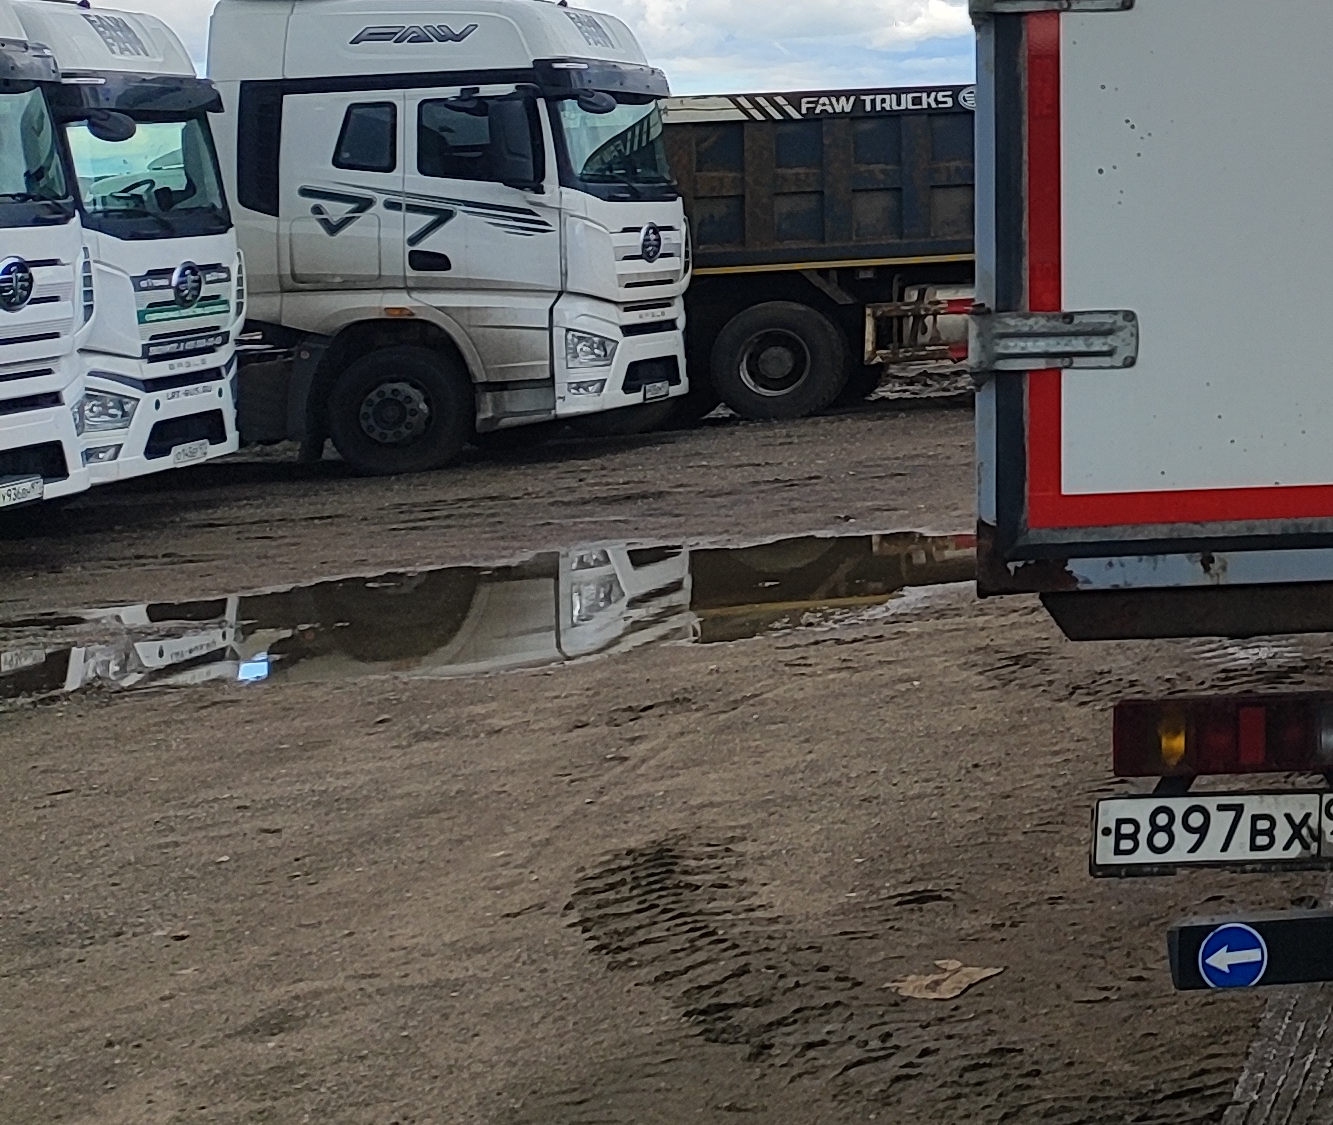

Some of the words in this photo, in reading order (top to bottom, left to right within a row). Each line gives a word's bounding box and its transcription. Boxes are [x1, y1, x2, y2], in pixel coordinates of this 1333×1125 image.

[349, 24, 478, 45] FAW
[800, 95, 856, 115] FAW
[860, 90, 953, 113] TRUCKS
